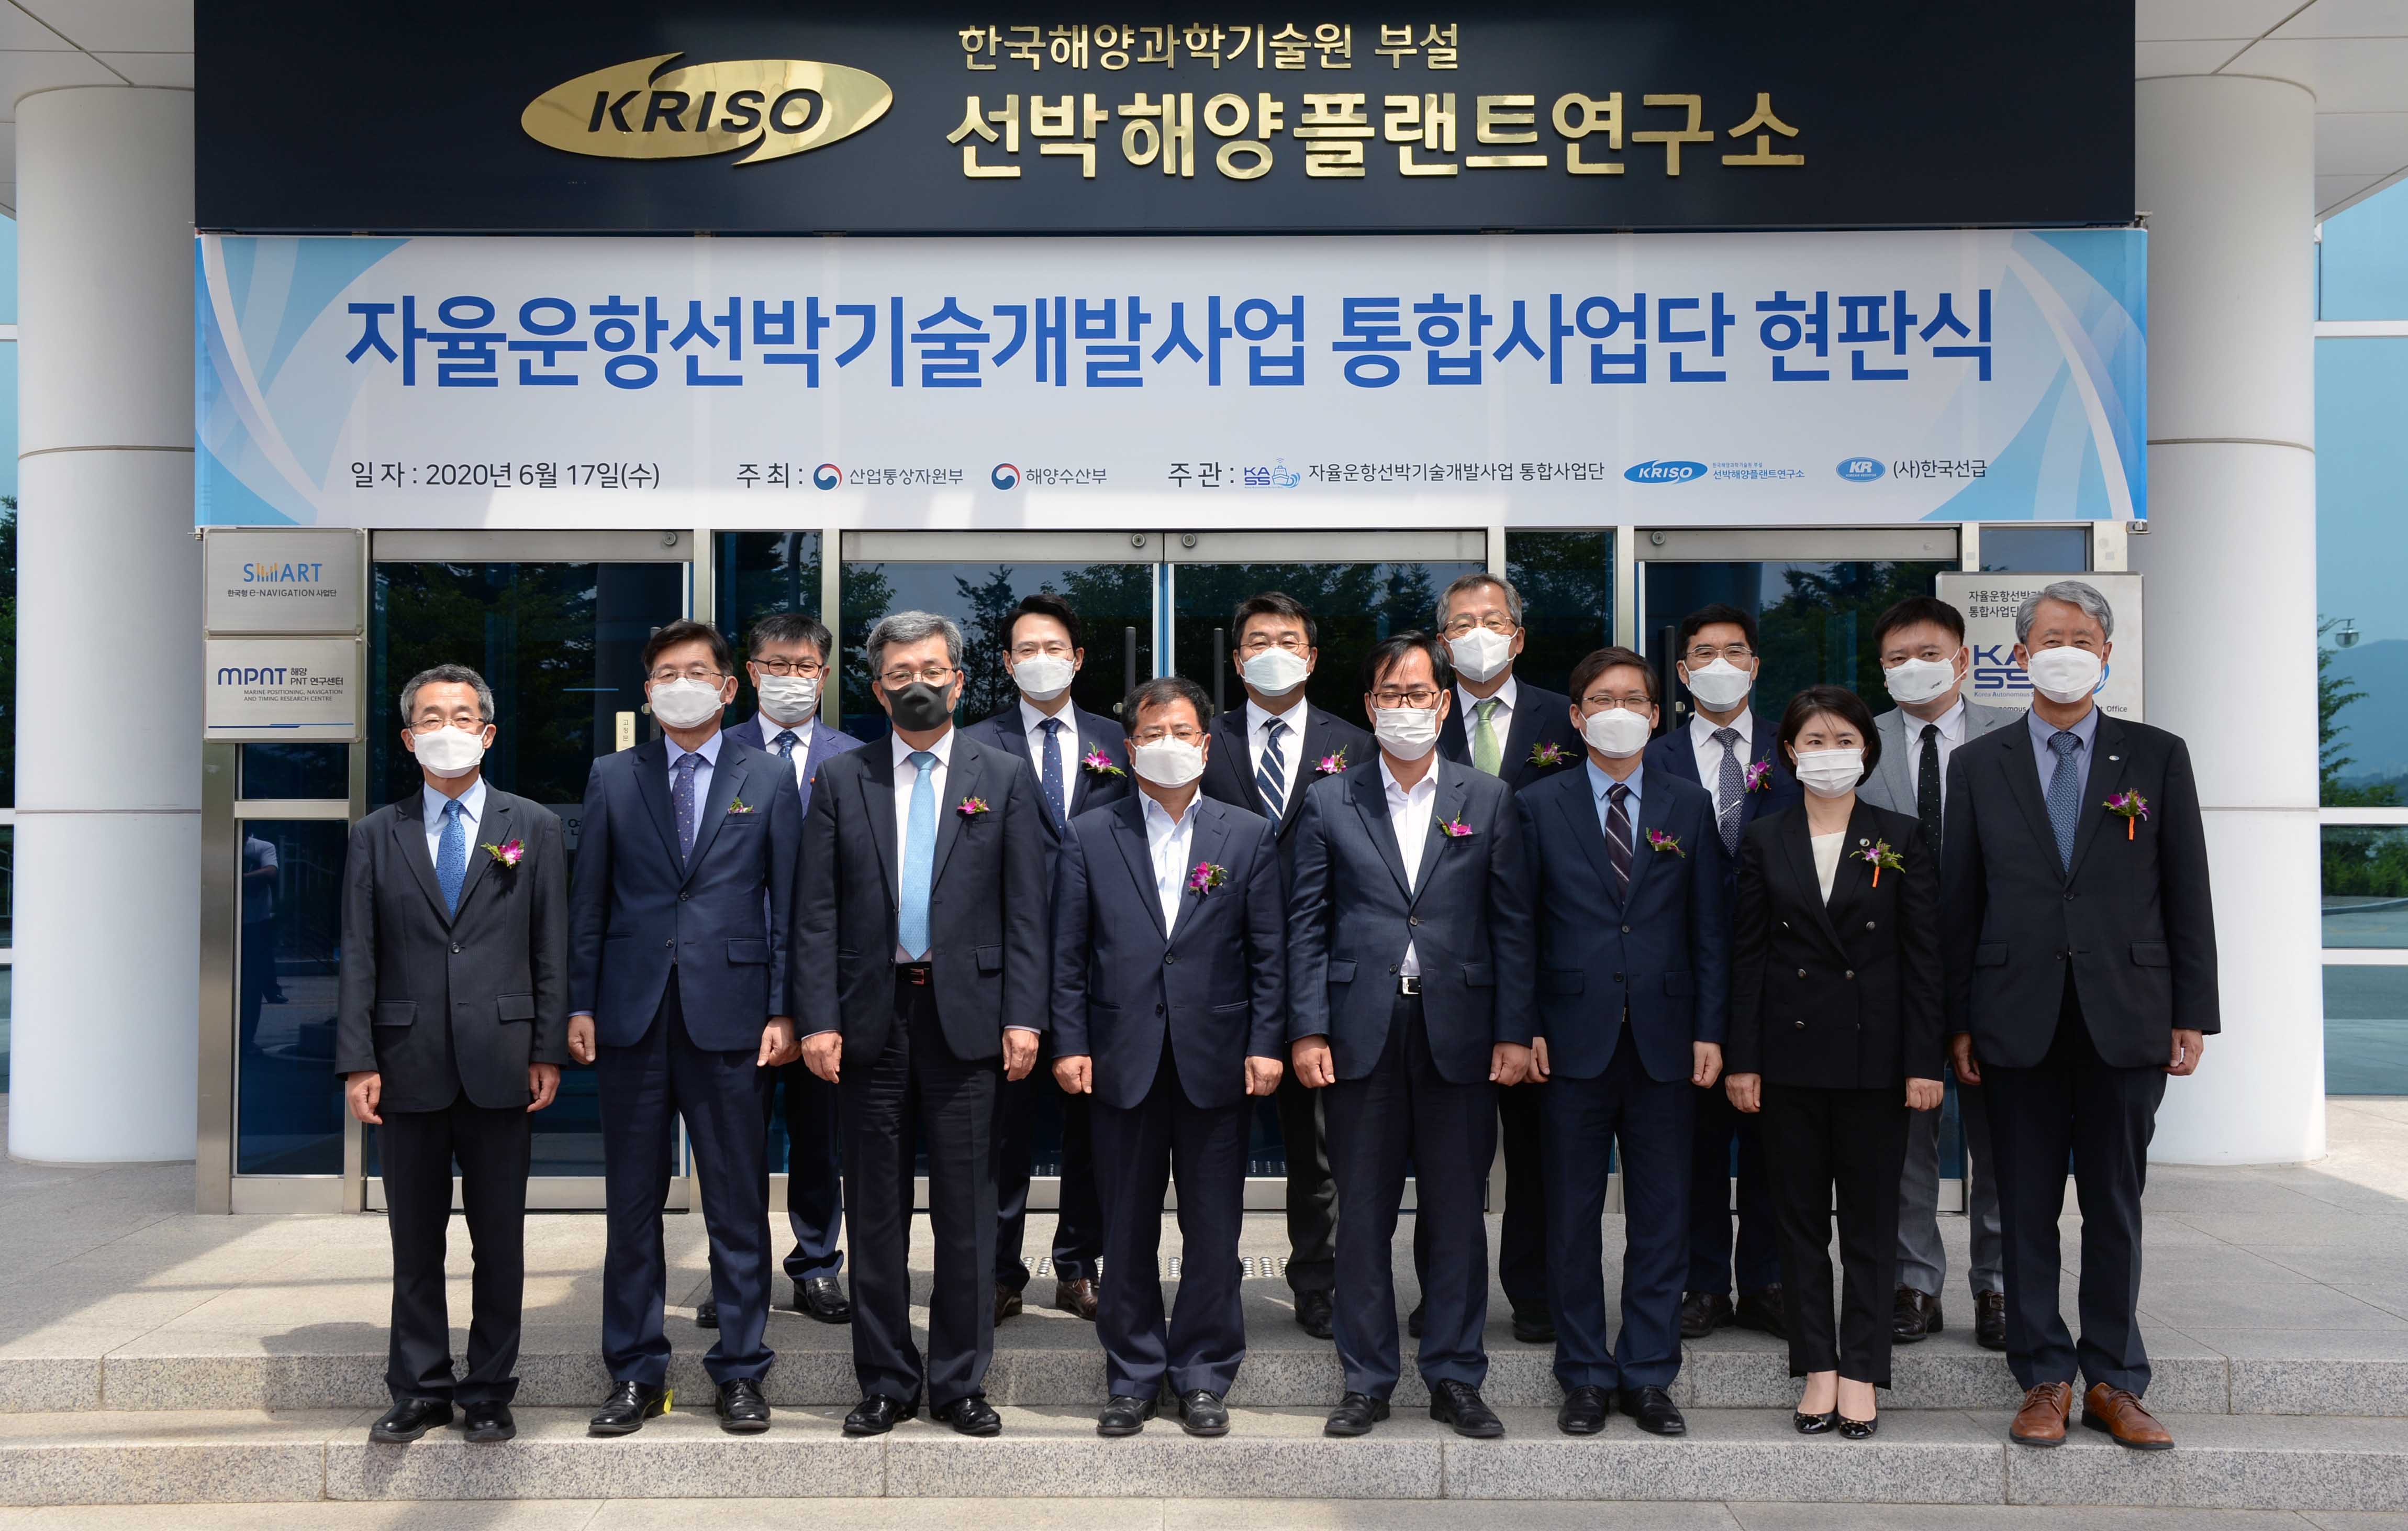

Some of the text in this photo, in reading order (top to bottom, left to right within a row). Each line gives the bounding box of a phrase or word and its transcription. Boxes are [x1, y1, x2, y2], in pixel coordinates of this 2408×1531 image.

[959, 23, 1457, 70] 한국해양과학기술원 부설
[587, 88, 824, 134] KRISO
[946, 92, 1803, 180] 선박해양플랜트연구소
[345, 289, 1991, 389] 자율운항선박기술개발사업 통합사업단 현판식
[427, 462, 510, 487] 2020년
[520, 462, 556, 488] 6월
[567, 463, 659, 489] 17일(수)
[850, 469, 963, 485] 산업통상자원부
[1026, 469, 1107, 484] 해양수산부
[1309, 462, 1604, 482] 자율운항선박기술개발사업 통합사업단
[1638, 467, 1693, 479] KRISO
[1713, 469, 1805, 480] 선박해양플랜트연구소
[1849, 461, 1872, 473] KR
[1893, 459, 1988, 480] (사)한국선급
[243, 562, 323, 582] SMART
[291, 668, 307, 676] 해양
[310, 677, 343, 685] 연구센터
